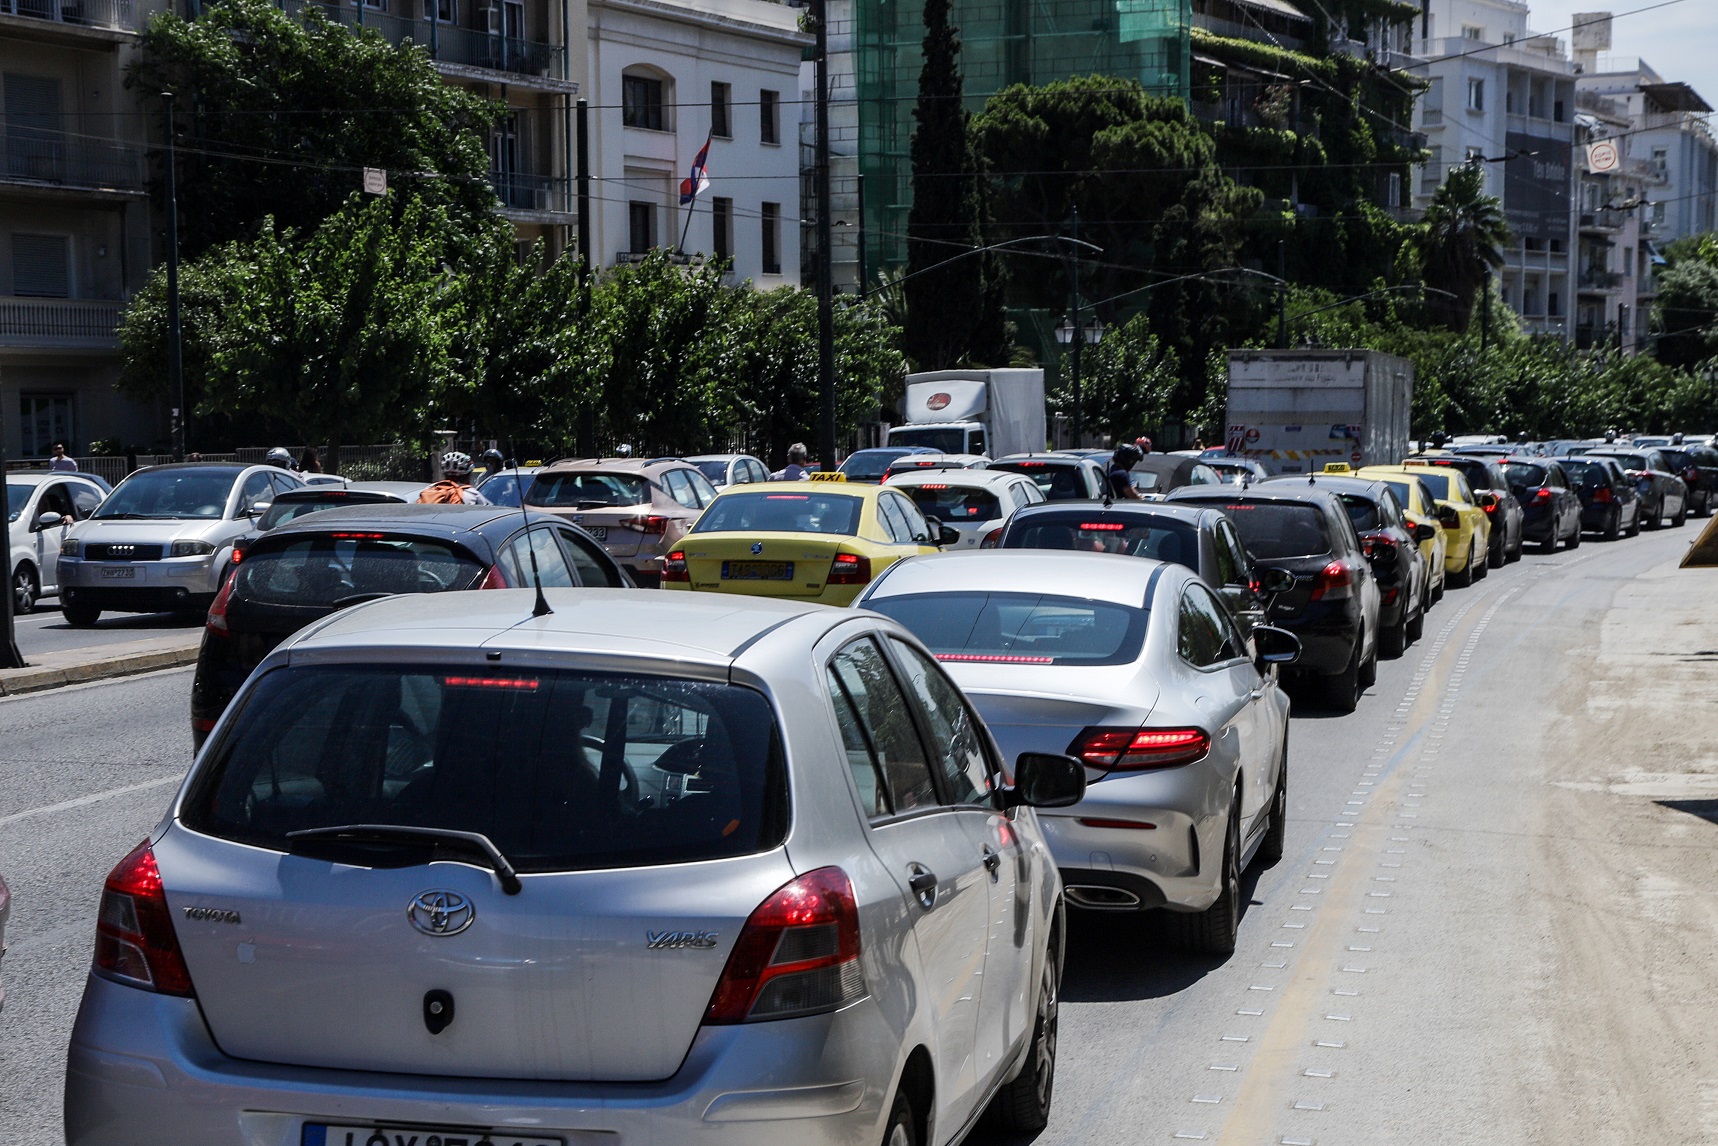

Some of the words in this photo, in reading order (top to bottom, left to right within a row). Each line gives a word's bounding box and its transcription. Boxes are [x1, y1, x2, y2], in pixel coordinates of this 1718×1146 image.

[811, 474, 841, 482] TAXI
[183, 907, 241, 924] TOYOTA
[647, 930, 718, 949] YARIS
